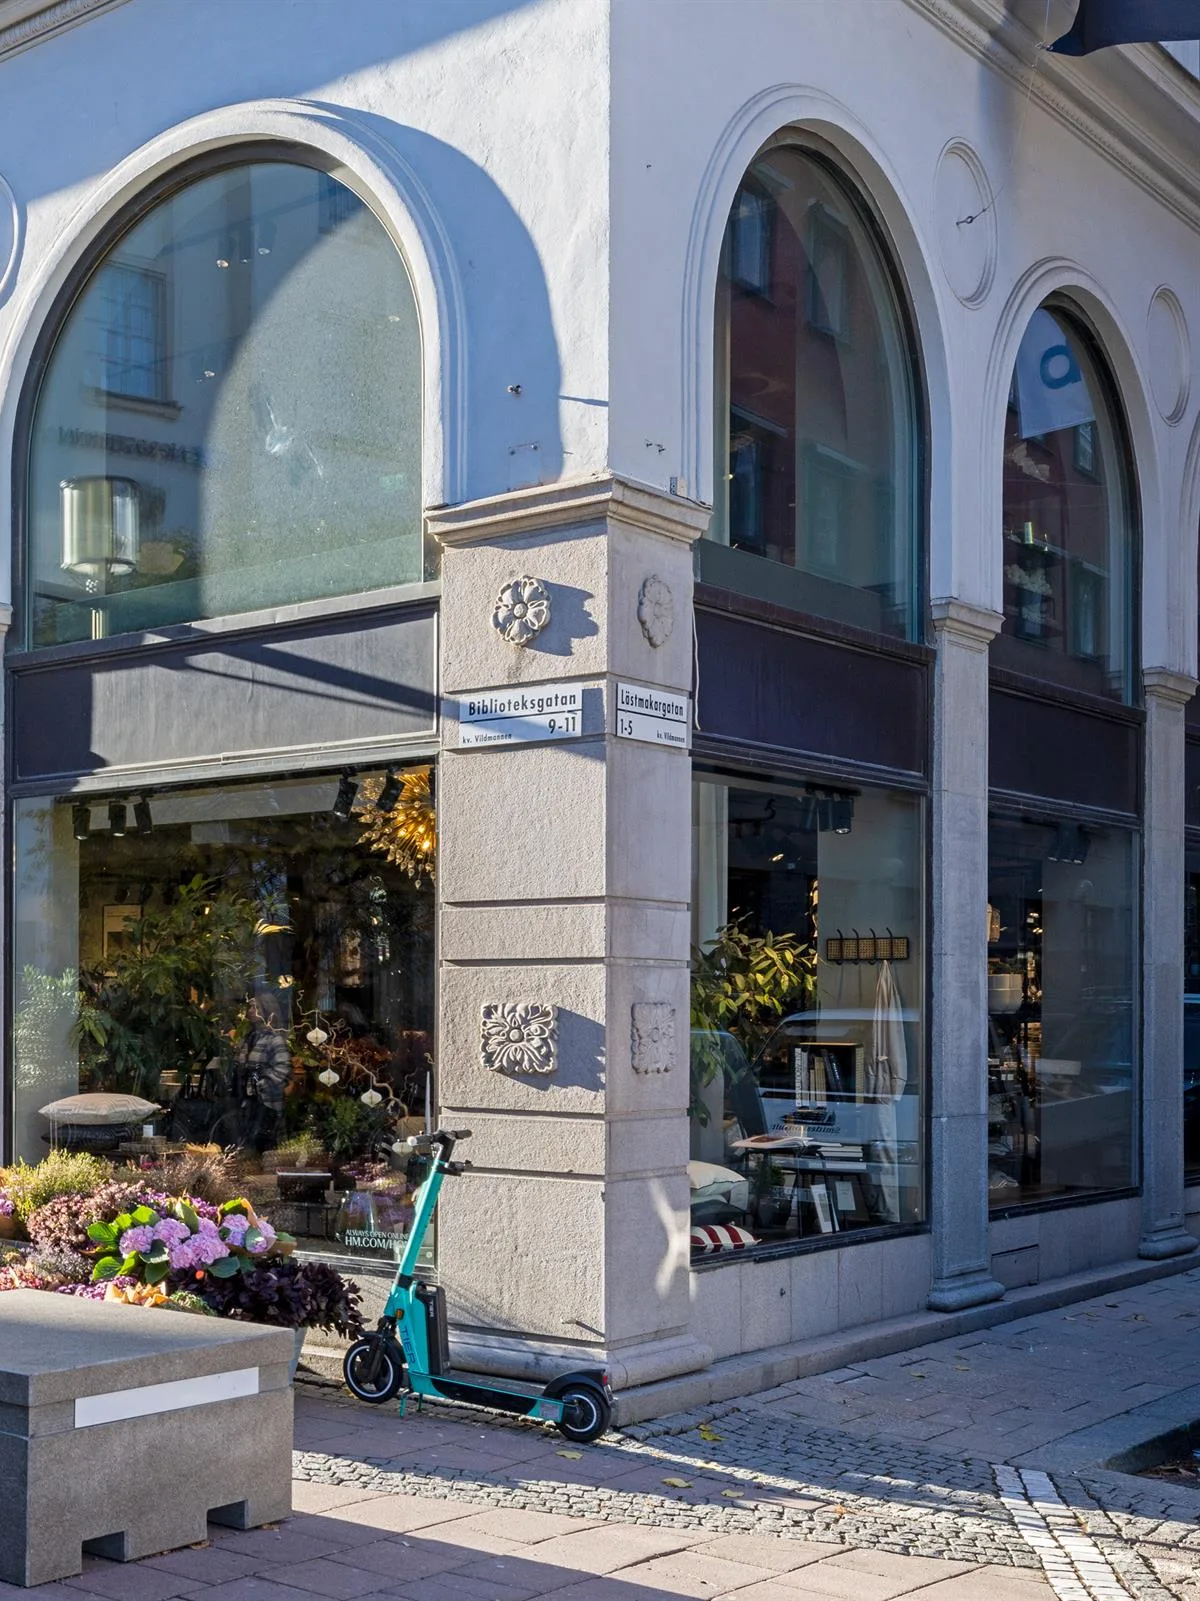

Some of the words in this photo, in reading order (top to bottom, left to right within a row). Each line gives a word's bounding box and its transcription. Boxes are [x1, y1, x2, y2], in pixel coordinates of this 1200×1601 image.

[469, 693, 576, 716] Biblioteksgatan
[621, 689, 684, 717] Lästmakargatan
[548, 716, 576, 734] 9-11
[620, 718, 633, 735] 1-5
[345, 1228, 369, 1238] ALWAYS
[369, 1230, 387, 1239] OPEN
[400, 1325, 416, 1364] TIER
